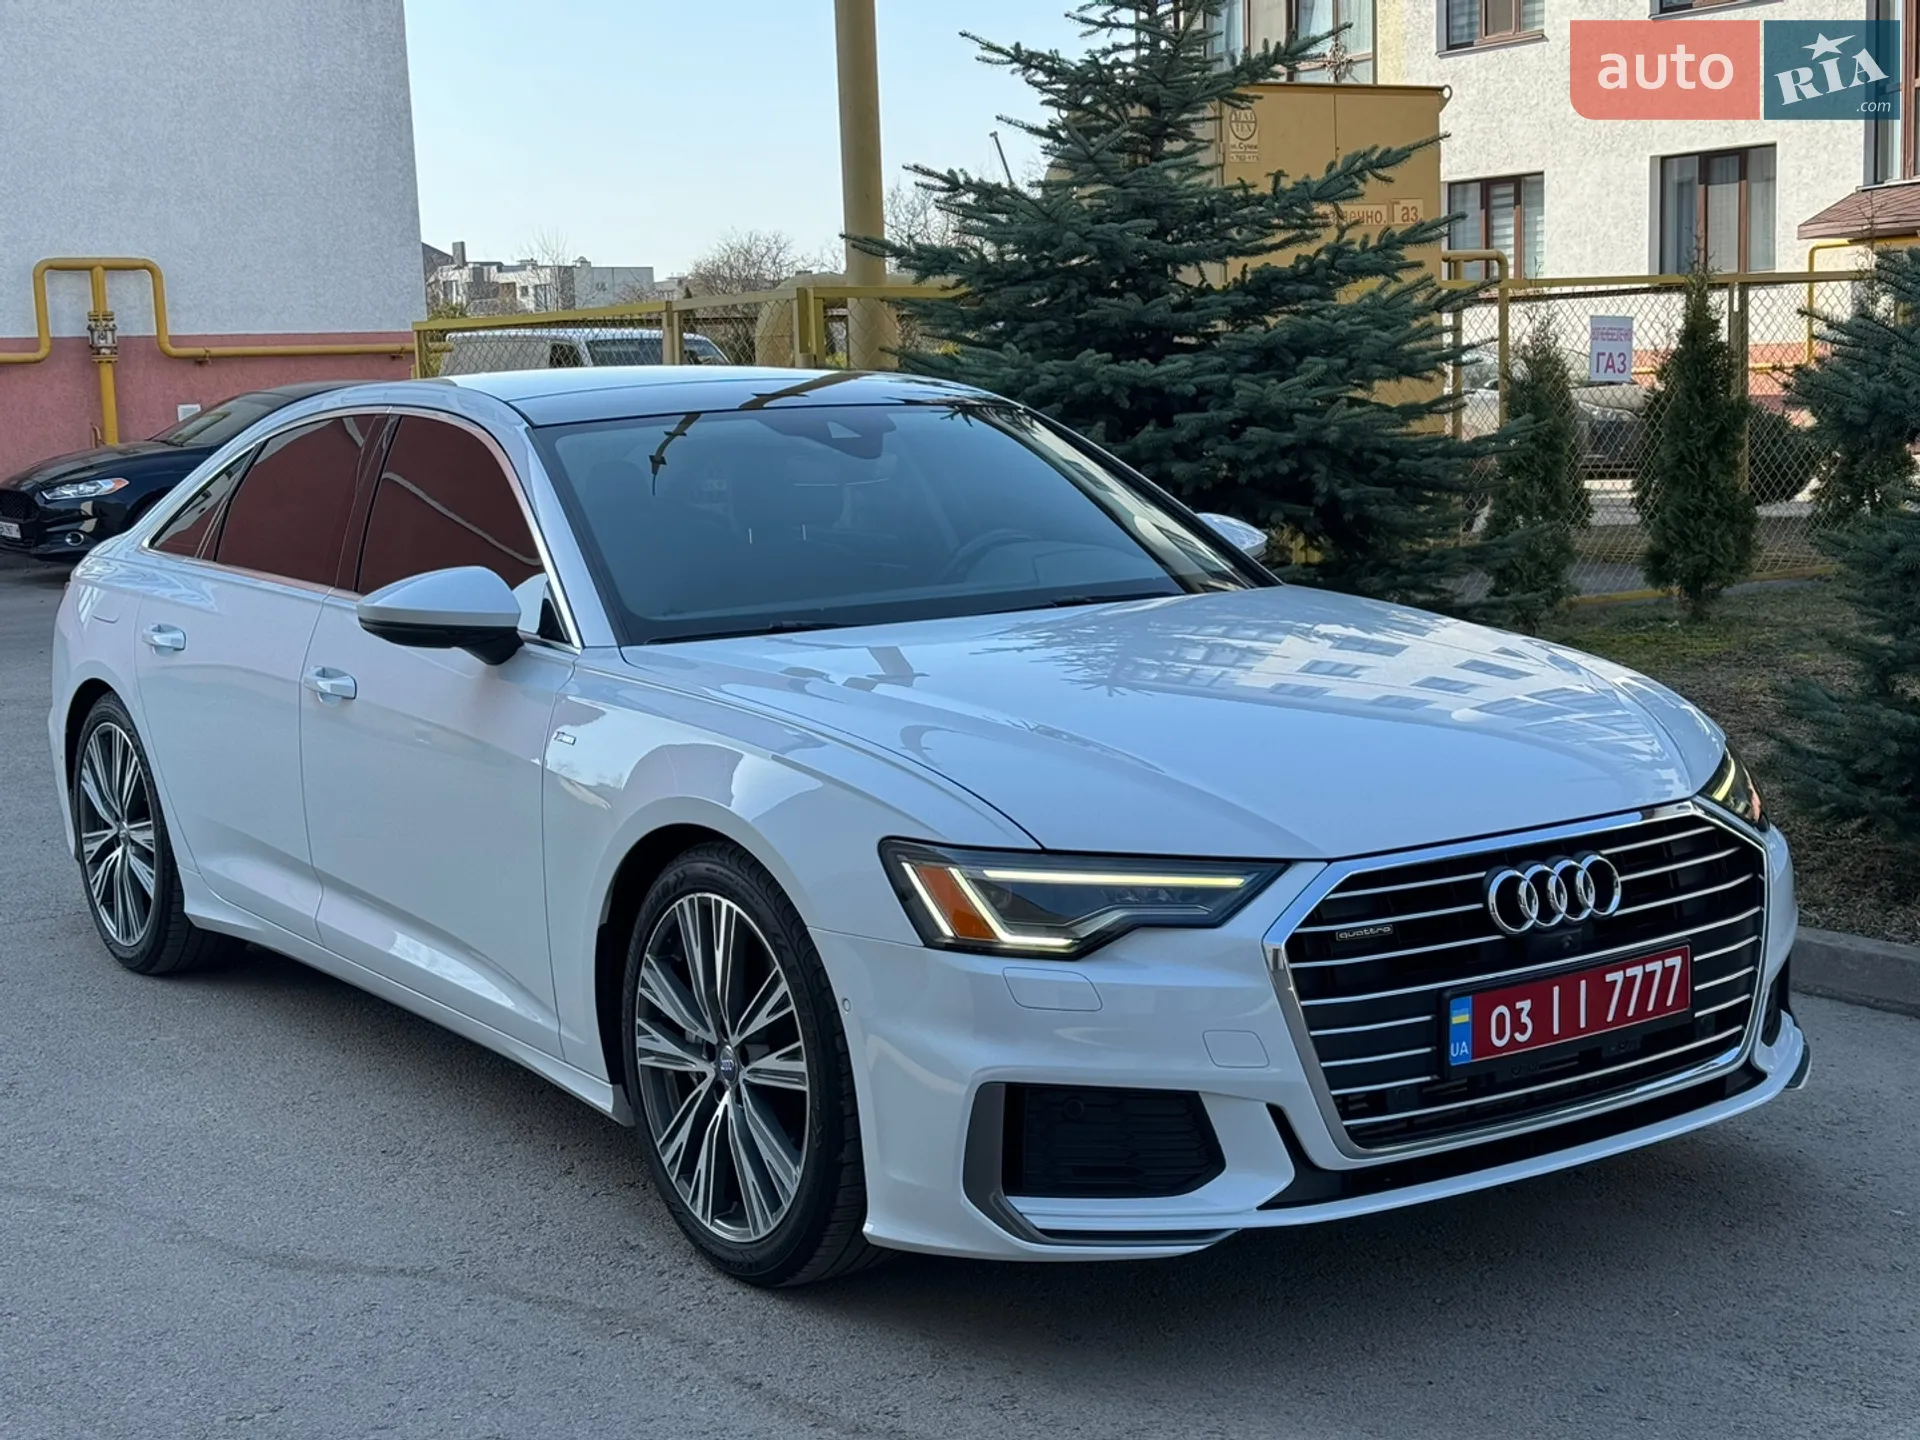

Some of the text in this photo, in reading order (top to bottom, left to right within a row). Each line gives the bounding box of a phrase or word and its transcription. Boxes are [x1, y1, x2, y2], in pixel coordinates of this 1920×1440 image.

[1596, 351, 1627, 374] ГАЗ
[1338, 926, 1392, 939] quattro
[1490, 998, 1533, 1047] 03
[1605, 955, 1683, 1022] 7777
[1450, 1041, 1469, 1058] UA
